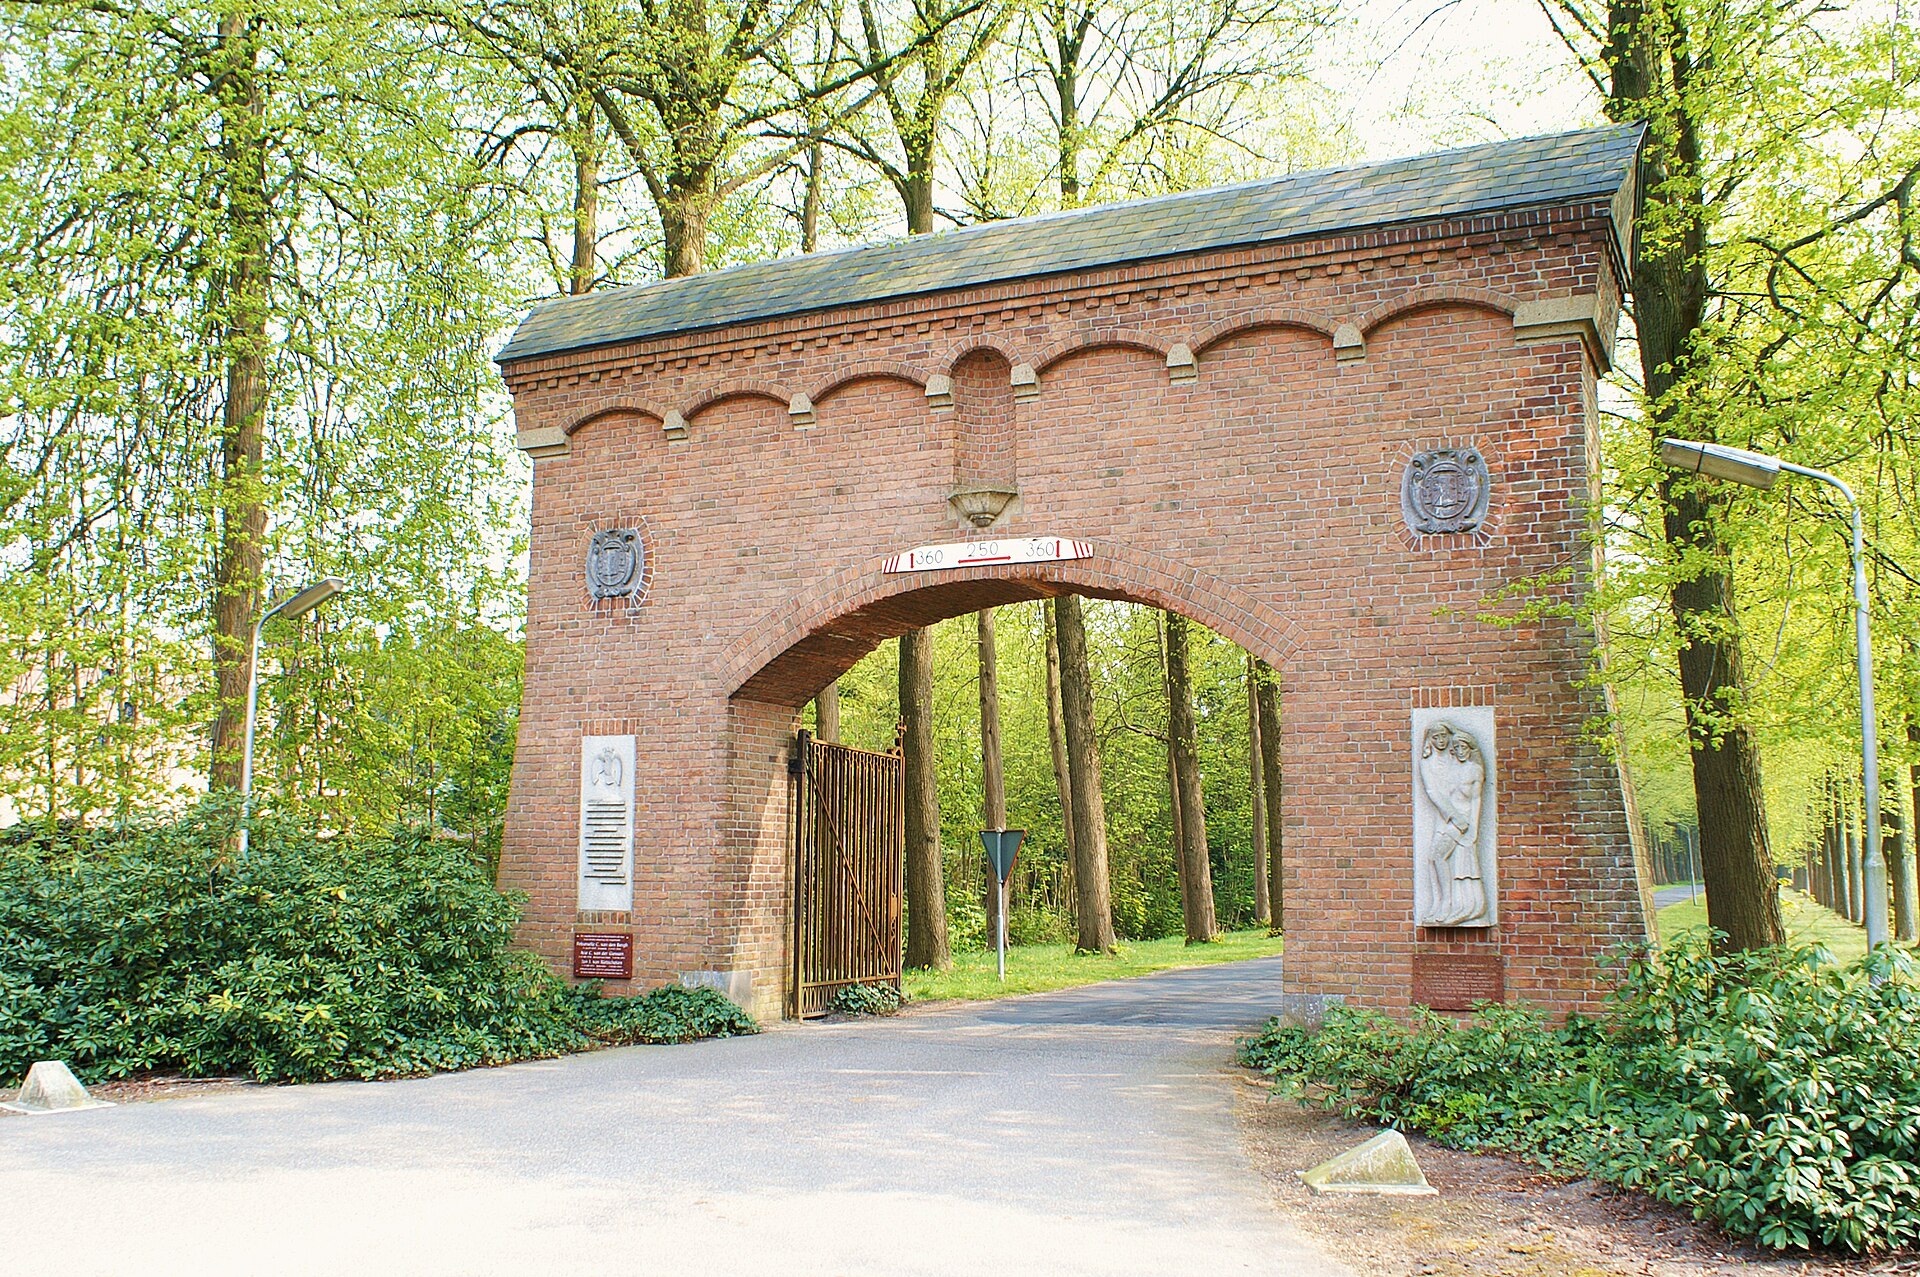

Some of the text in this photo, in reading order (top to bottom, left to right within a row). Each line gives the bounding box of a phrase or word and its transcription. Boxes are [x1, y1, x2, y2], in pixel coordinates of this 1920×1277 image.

[916, 542, 1055, 564] 360 250 360
